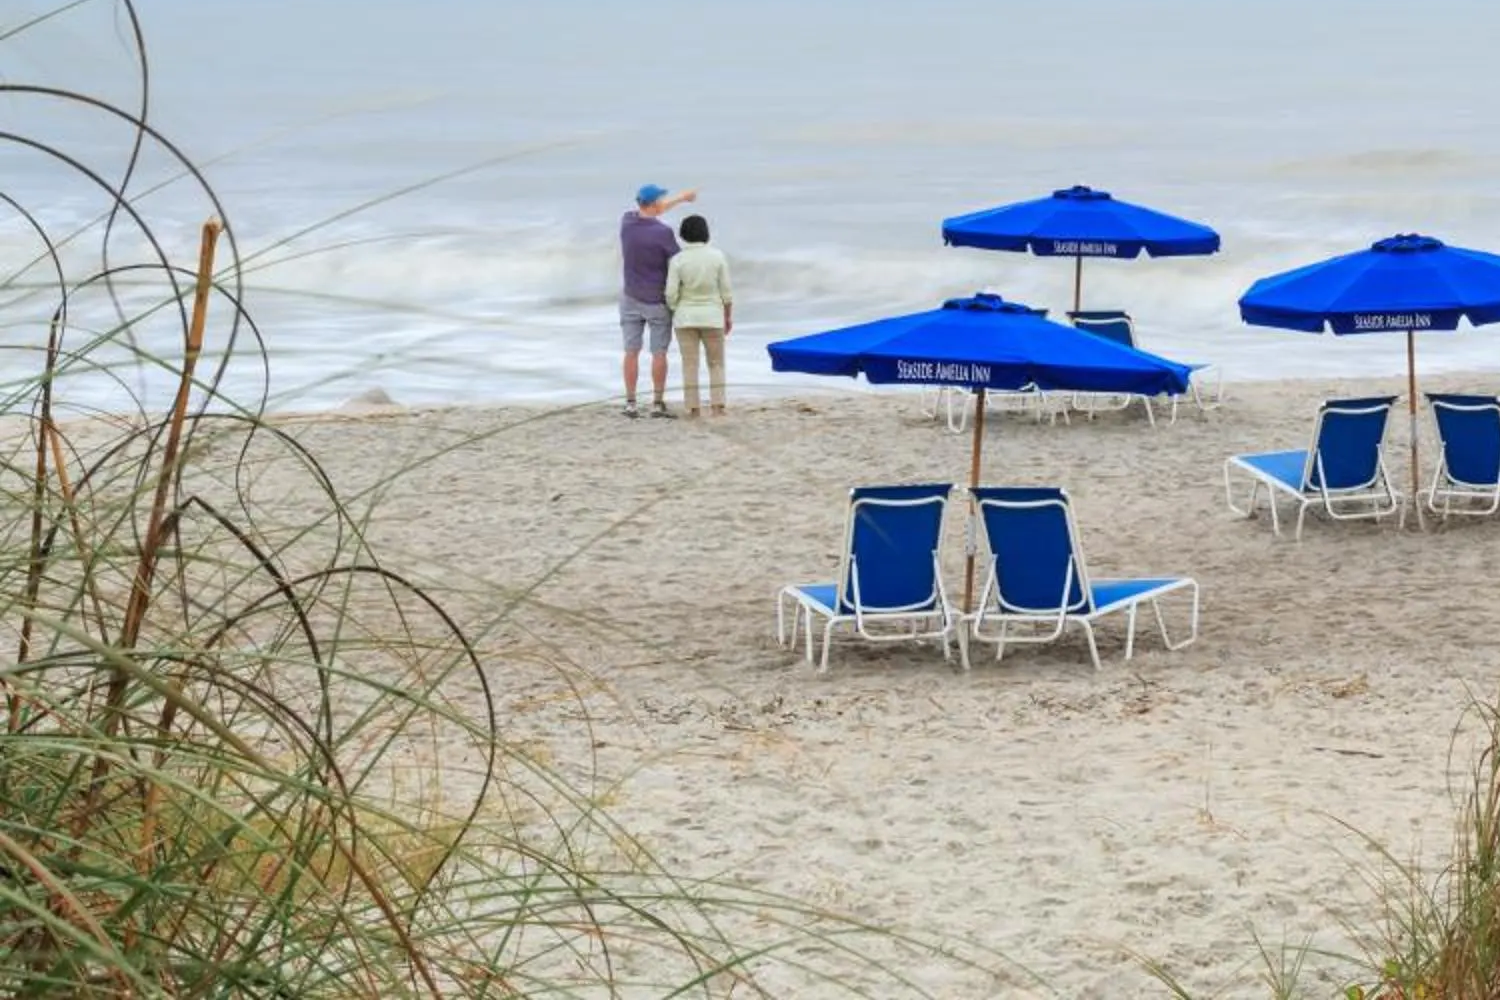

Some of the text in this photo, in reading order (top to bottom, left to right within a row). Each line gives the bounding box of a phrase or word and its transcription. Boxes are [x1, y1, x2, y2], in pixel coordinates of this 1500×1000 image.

[1354, 312, 1431, 329] SEASIDE AMELIA INN
[897, 360, 991, 382] SEASIDE AMELIA INN
